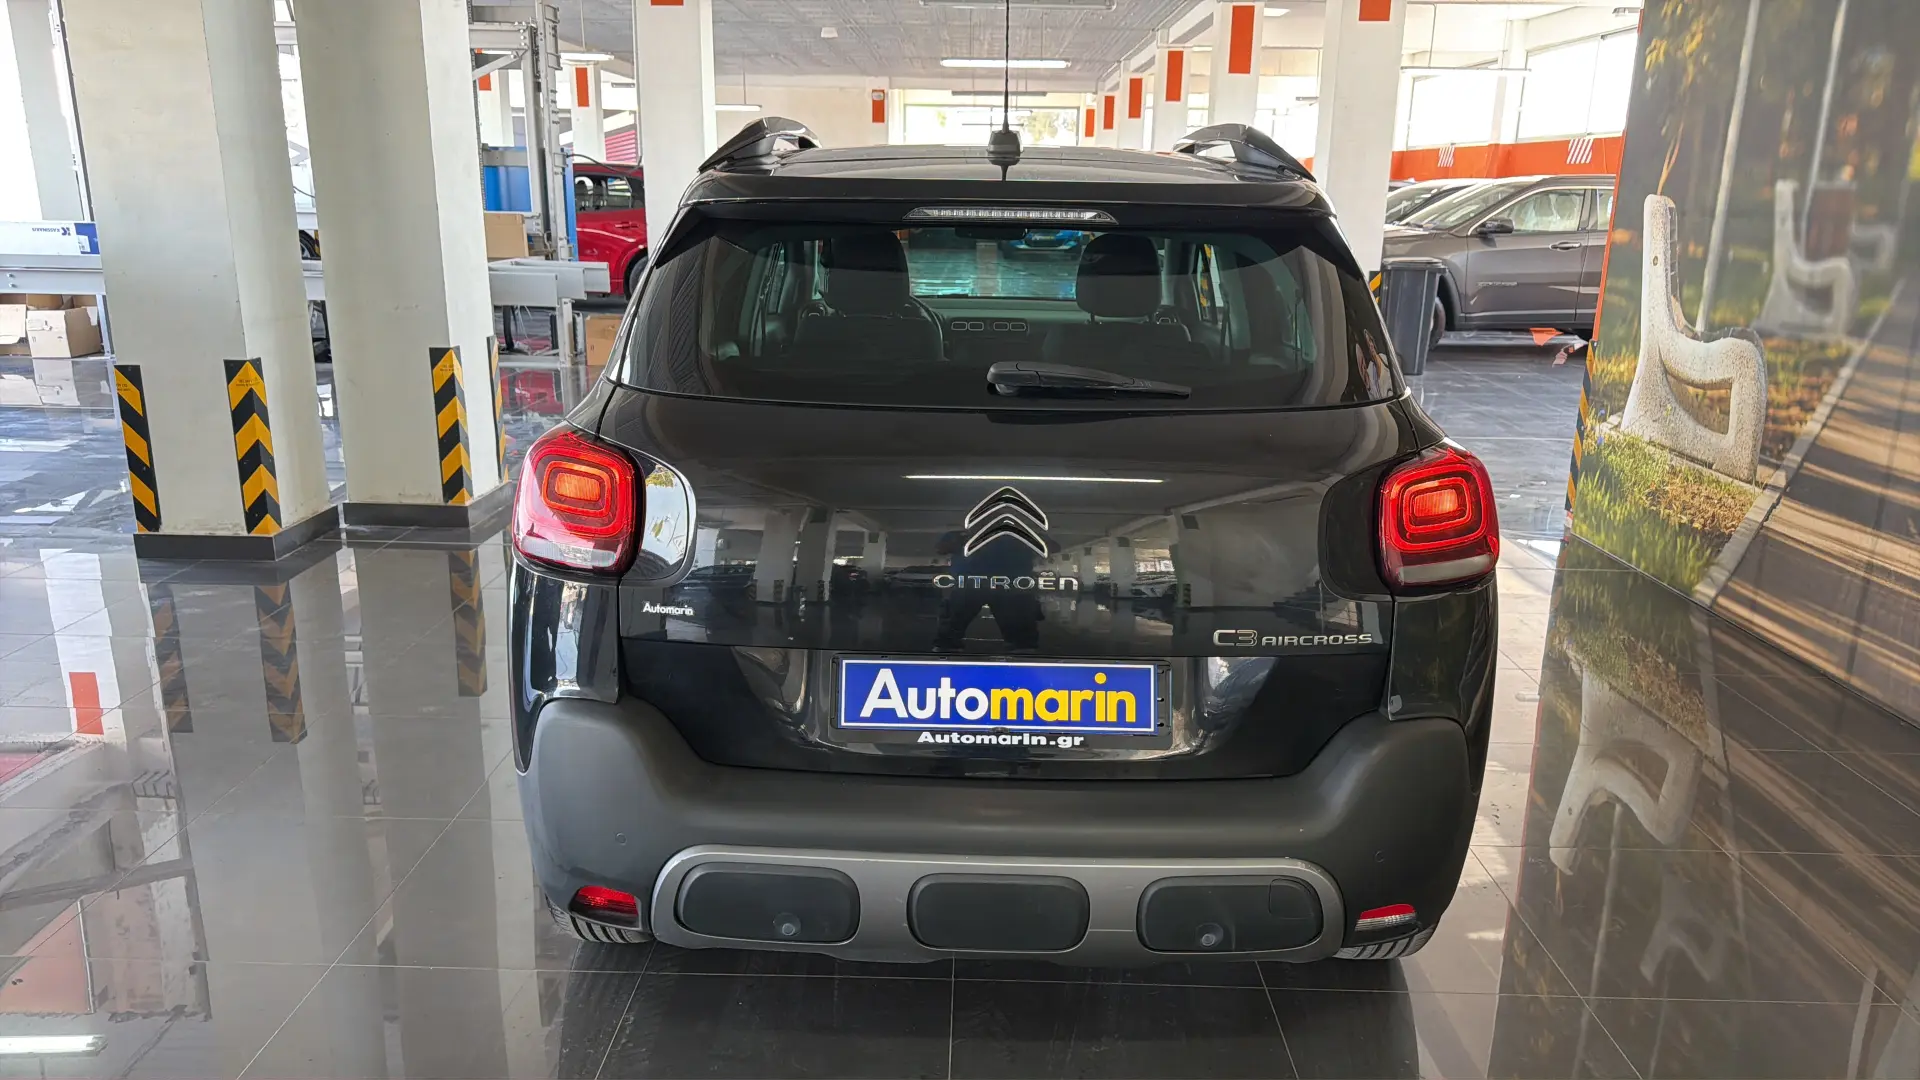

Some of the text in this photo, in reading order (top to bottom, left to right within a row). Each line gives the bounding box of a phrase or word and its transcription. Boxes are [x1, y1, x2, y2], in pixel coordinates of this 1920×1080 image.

[933, 571, 1078, 591] CITROËN
[642, 602, 694, 616] Automarin
[1213, 629, 1373, 647] C3 AIRCROSS
[859, 668, 1136, 722] Automarin
[917, 731, 1085, 748] Automarin.gr
